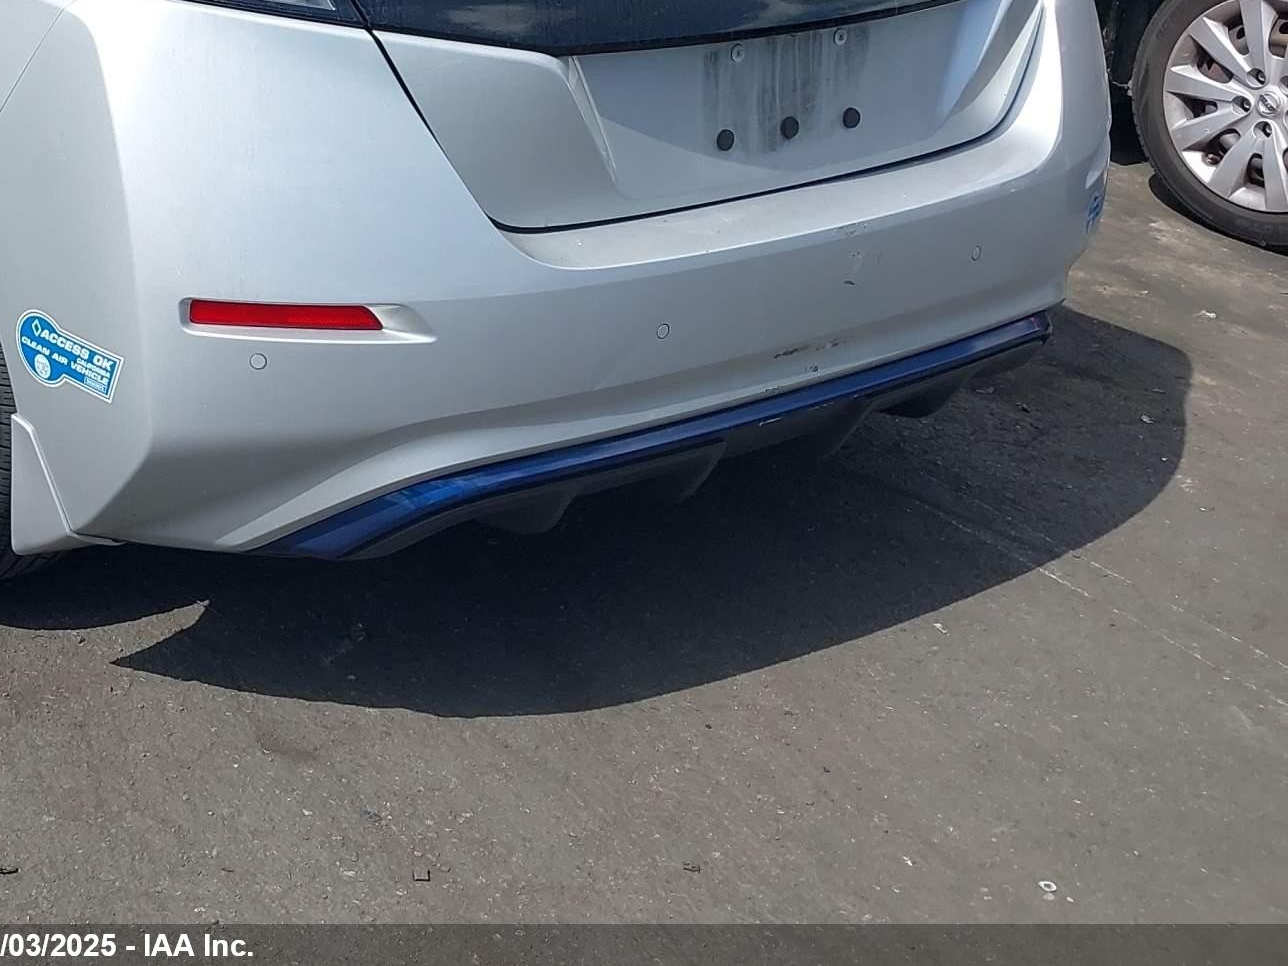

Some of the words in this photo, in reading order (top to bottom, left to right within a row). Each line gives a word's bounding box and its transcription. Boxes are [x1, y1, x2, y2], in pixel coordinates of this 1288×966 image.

[21, 335, 50, 356] CLEAN
[51, 352, 69, 366] AIR
[70, 360, 110, 384] VEHICLE
[40, 329, 90, 360] ACCESS
[92, 354, 114, 371] OK
